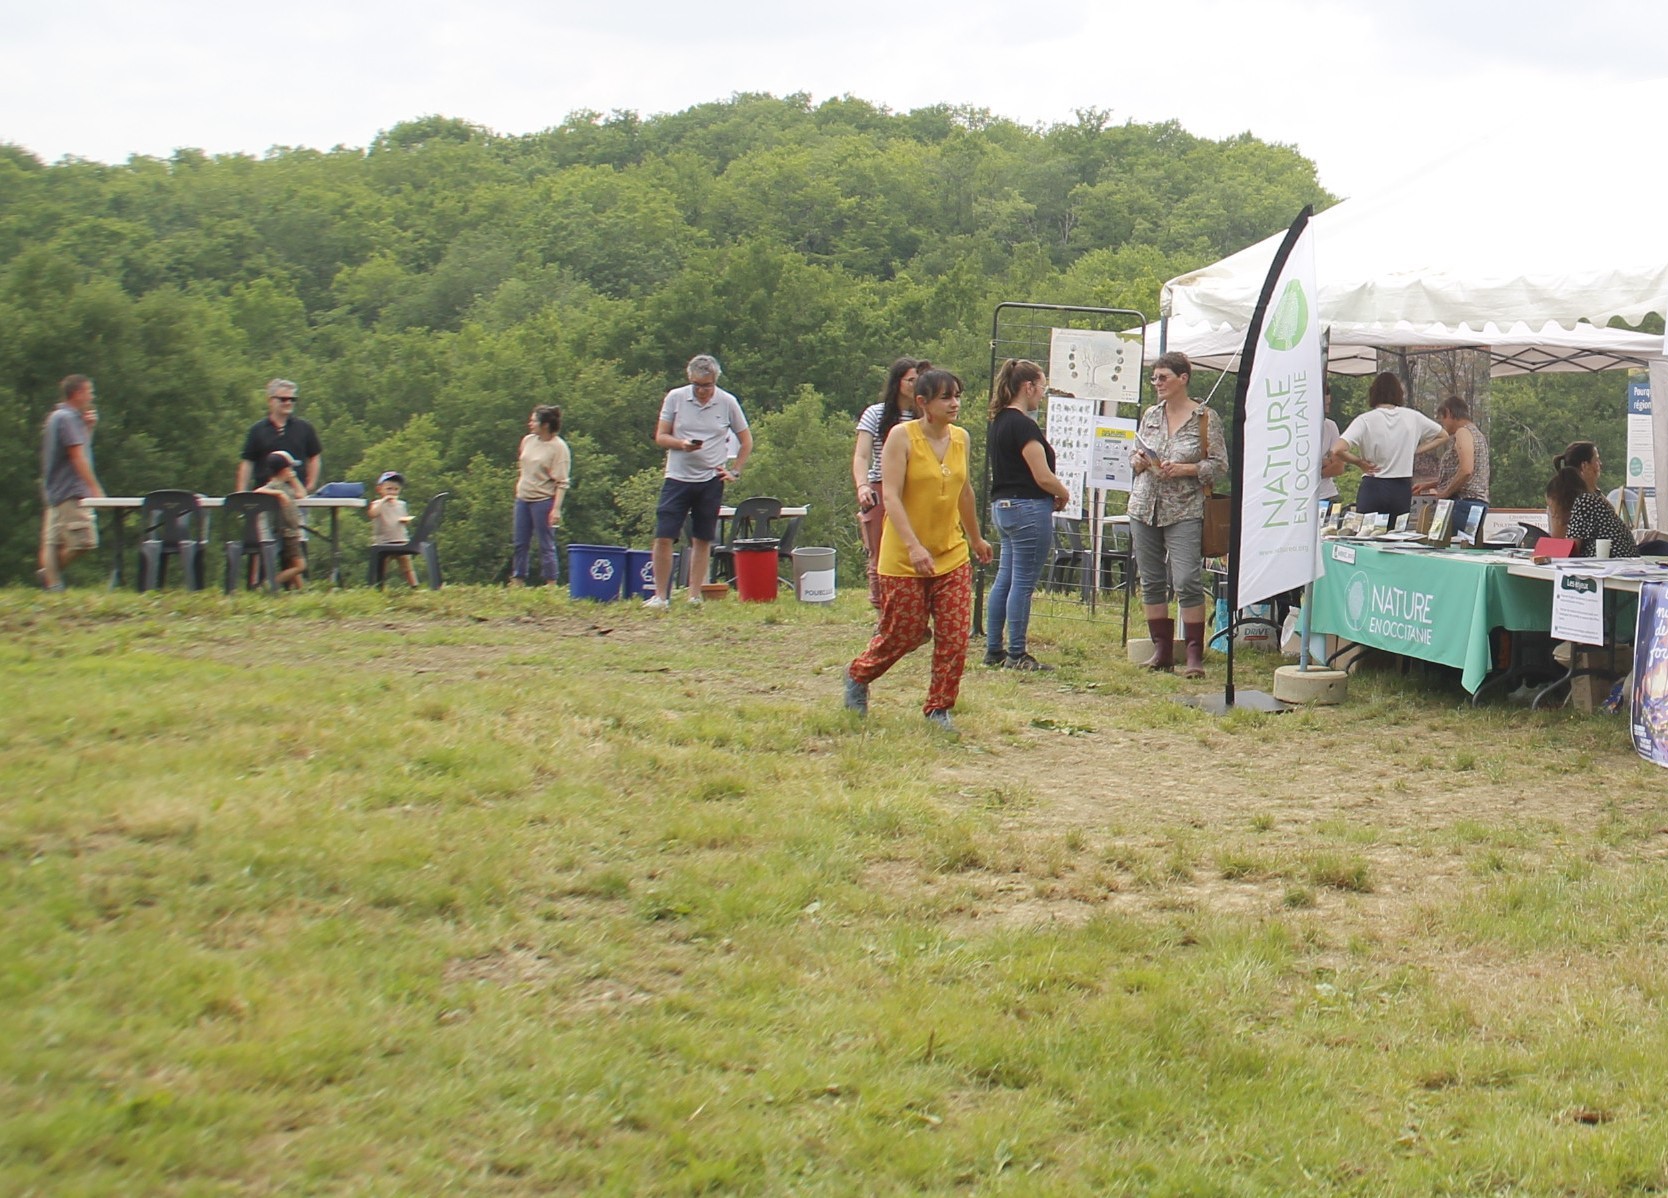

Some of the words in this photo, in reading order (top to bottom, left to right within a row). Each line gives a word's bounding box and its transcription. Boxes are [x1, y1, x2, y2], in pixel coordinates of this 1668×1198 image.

[1633, 386, 1651, 398] Pourq
[1633, 399, 1652, 411] région
[1294, 370, 1311, 491] OCCITANIE
[1262, 375, 1292, 529] NATURE
[1294, 498, 1308, 524] EN
[1567, 578, 1575, 587] Les
[1371, 584, 1434, 624] NATURE
[1369, 617, 1383, 633] EN
[1382, 619, 1433, 645] OCCITANIE
